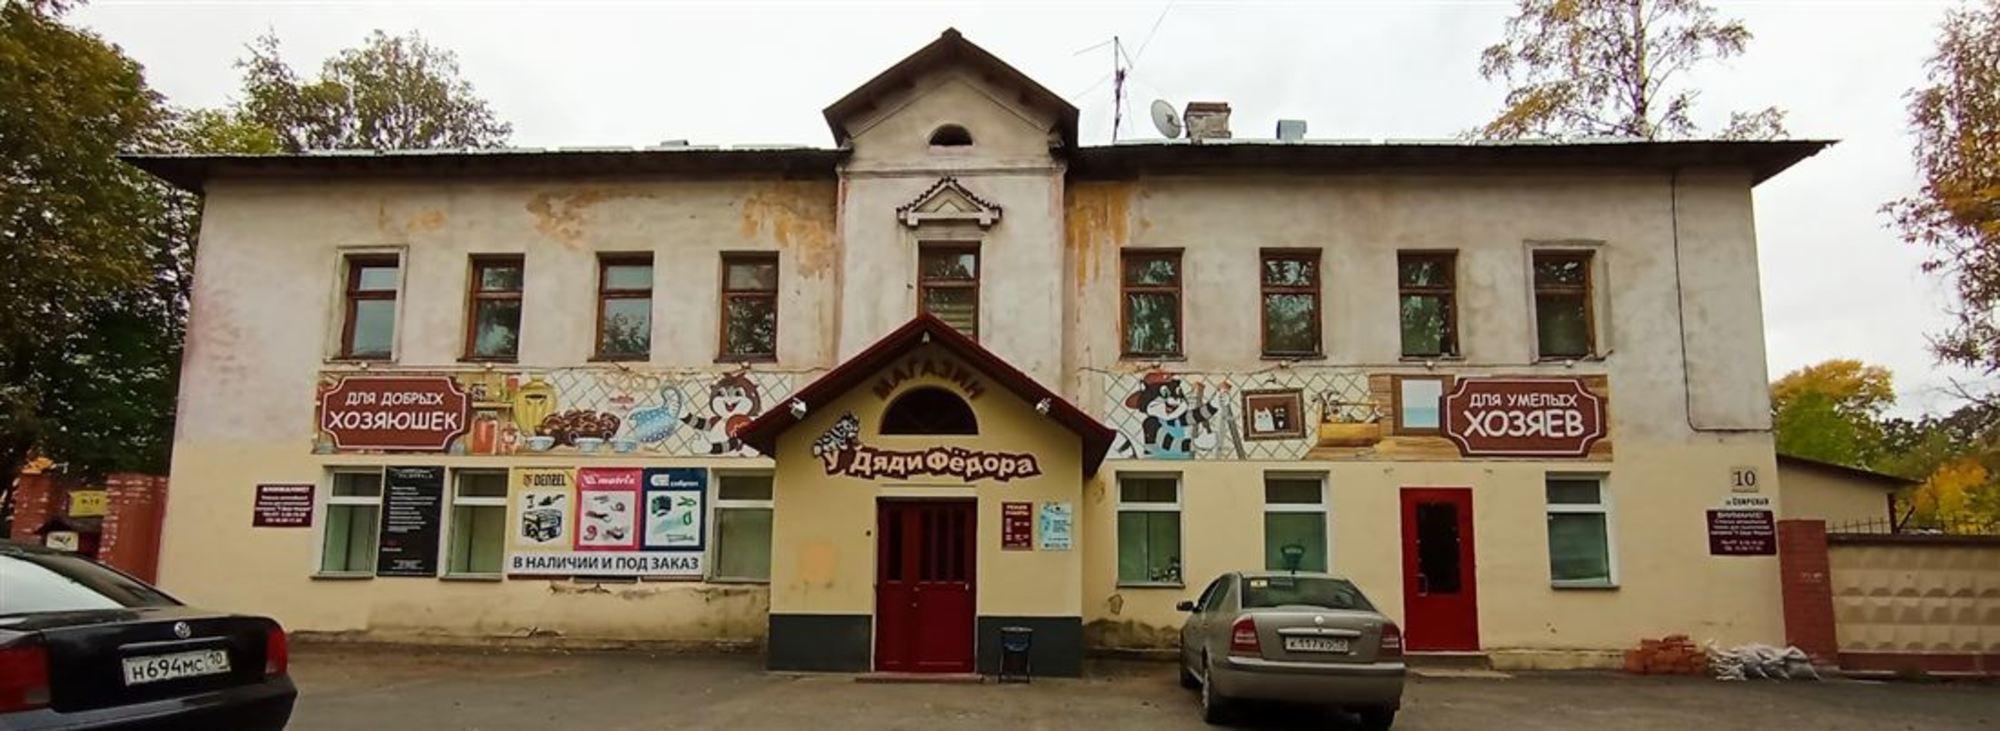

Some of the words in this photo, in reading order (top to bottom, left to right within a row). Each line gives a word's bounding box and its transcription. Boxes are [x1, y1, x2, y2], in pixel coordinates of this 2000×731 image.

[873, 358, 985, 400] МАГАЗИН
[345, 392, 376, 405] ДЛЯ
[381, 392, 444, 406] ДОБРЫХ
[1469, 394, 1502, 407] ДЛЯ
[1507, 393, 1578, 407] УМЕЛЫХ
[328, 411, 458, 430] ХОЗЯЮШЕК
[1463, 410, 1585, 438] ХОЗЯЕВ
[823, 451, 840, 474] У
[850, 450, 924, 477] Дяди
[926, 449, 1035, 478] Фёдора
[1734, 471, 1756, 487] 10
[514, 557, 524, 569] В
[526, 556, 599, 569] НАЛИЧИИ
[601, 556, 612, 569] И
[616, 556, 648, 571] ПОД
[651, 557, 699, 570] ЗАКАЗ
[131, 658, 204, 680] Н694МС
[209, 652, 223, 666] 10
